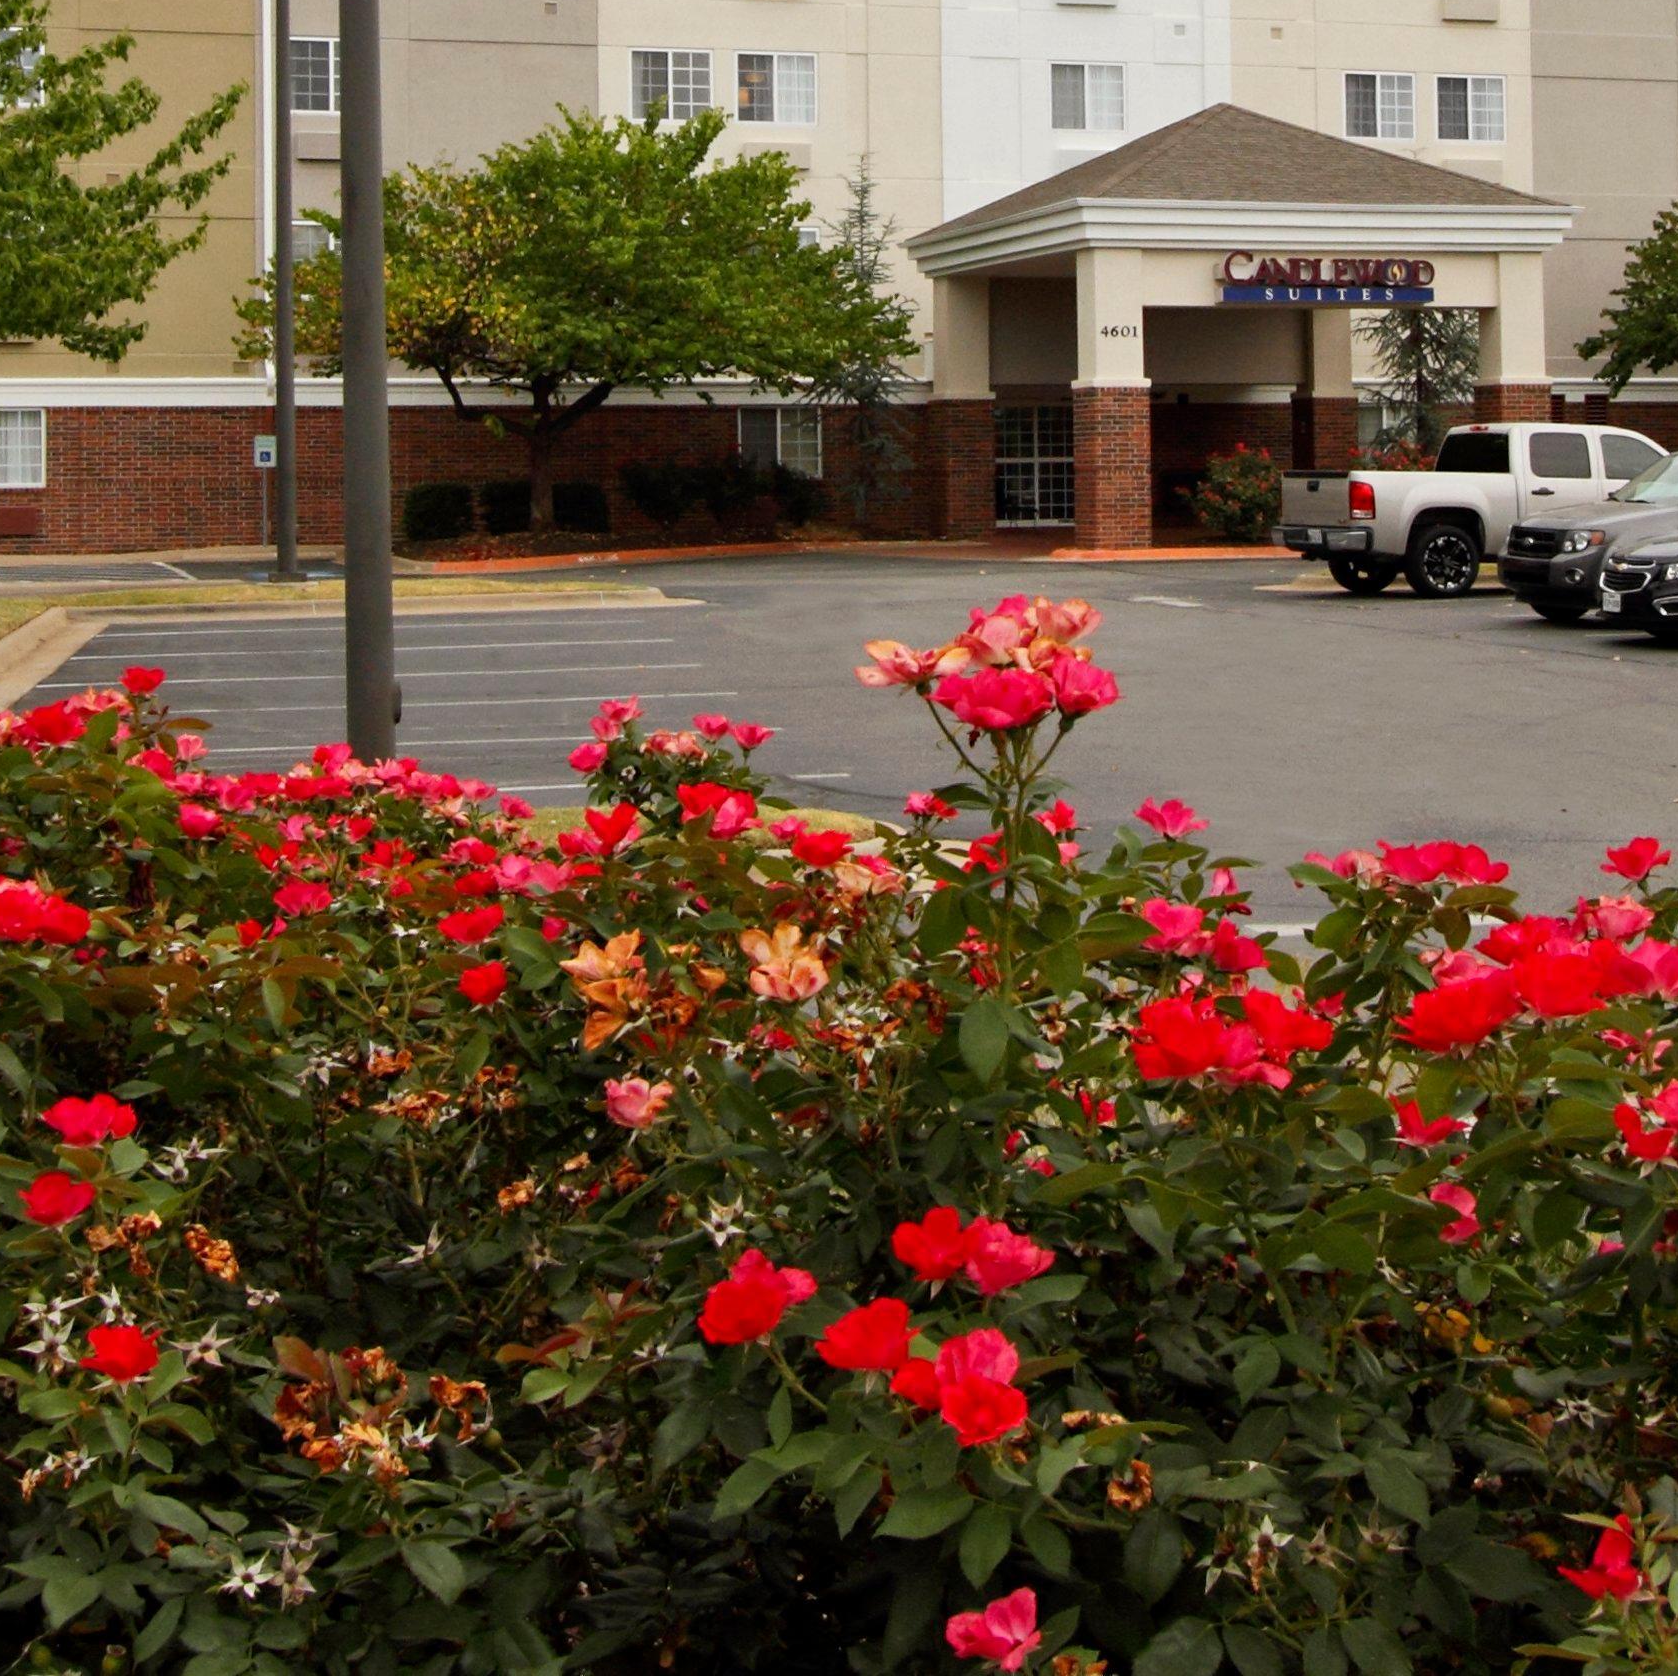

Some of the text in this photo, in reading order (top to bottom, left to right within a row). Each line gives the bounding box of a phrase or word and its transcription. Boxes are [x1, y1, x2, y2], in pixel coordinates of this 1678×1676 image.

[1224, 250, 1436, 287] CANDLEWOOD
[1265, 288, 1394, 301] SUITES
[1100, 325, 1138, 338] 4601
